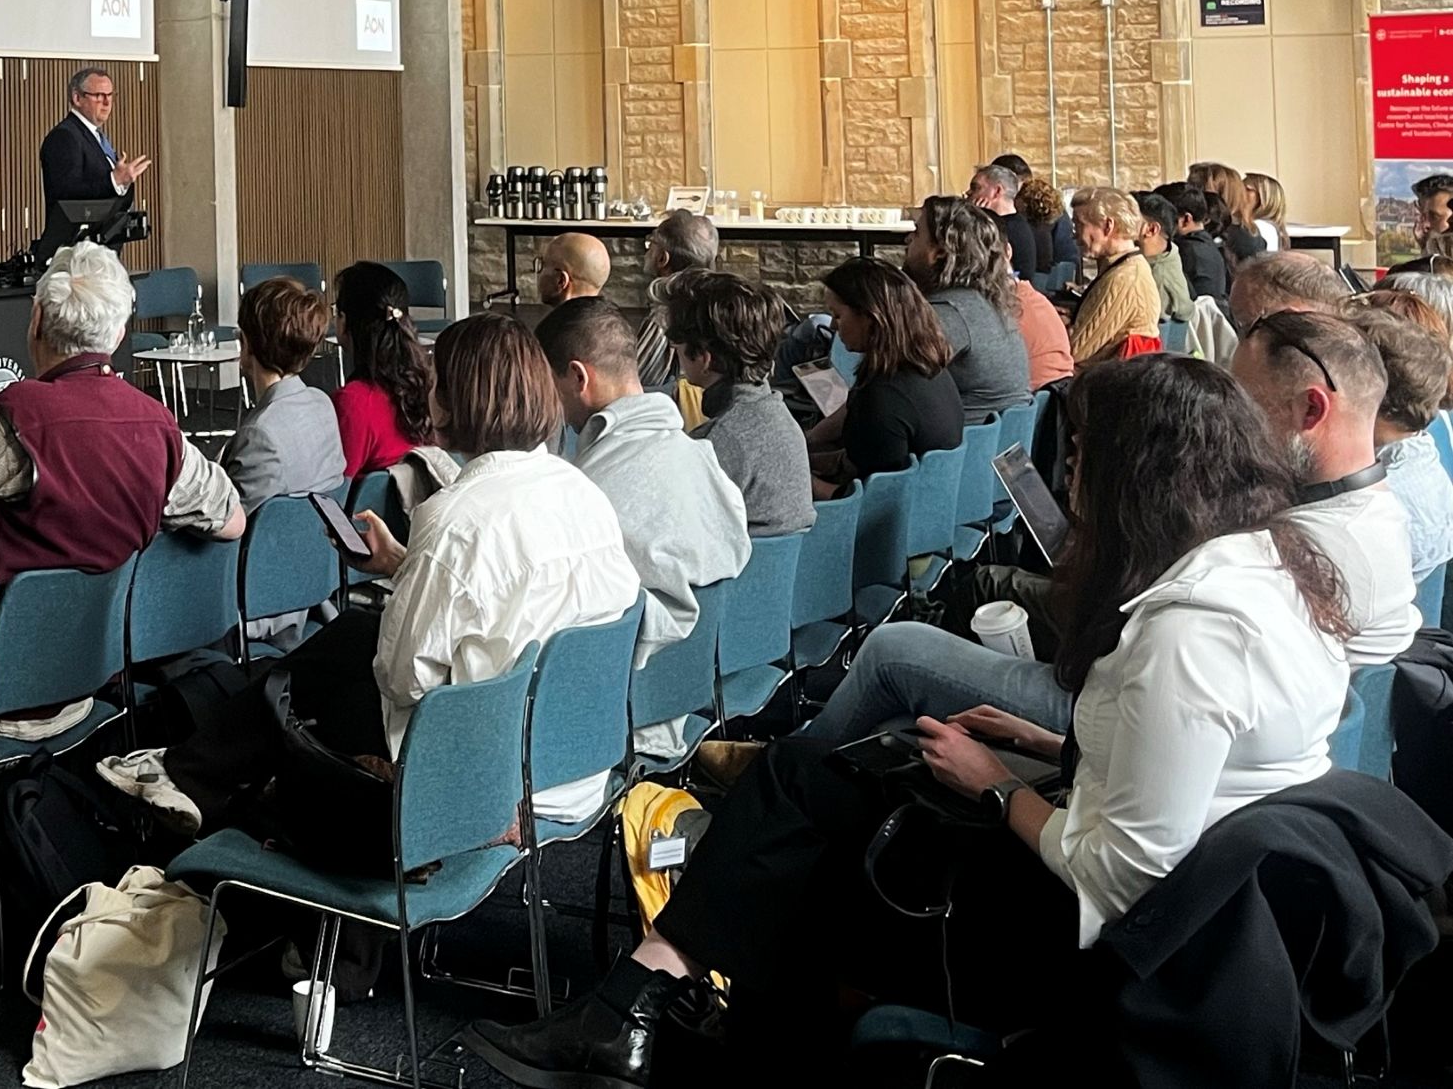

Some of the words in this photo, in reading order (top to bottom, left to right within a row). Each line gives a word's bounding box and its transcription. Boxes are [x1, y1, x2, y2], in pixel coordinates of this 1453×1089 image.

[1401, 73, 1442, 85] Shaping
[1442, 75, 1450, 83] a
[1376, 87, 1431, 98] sustainable
